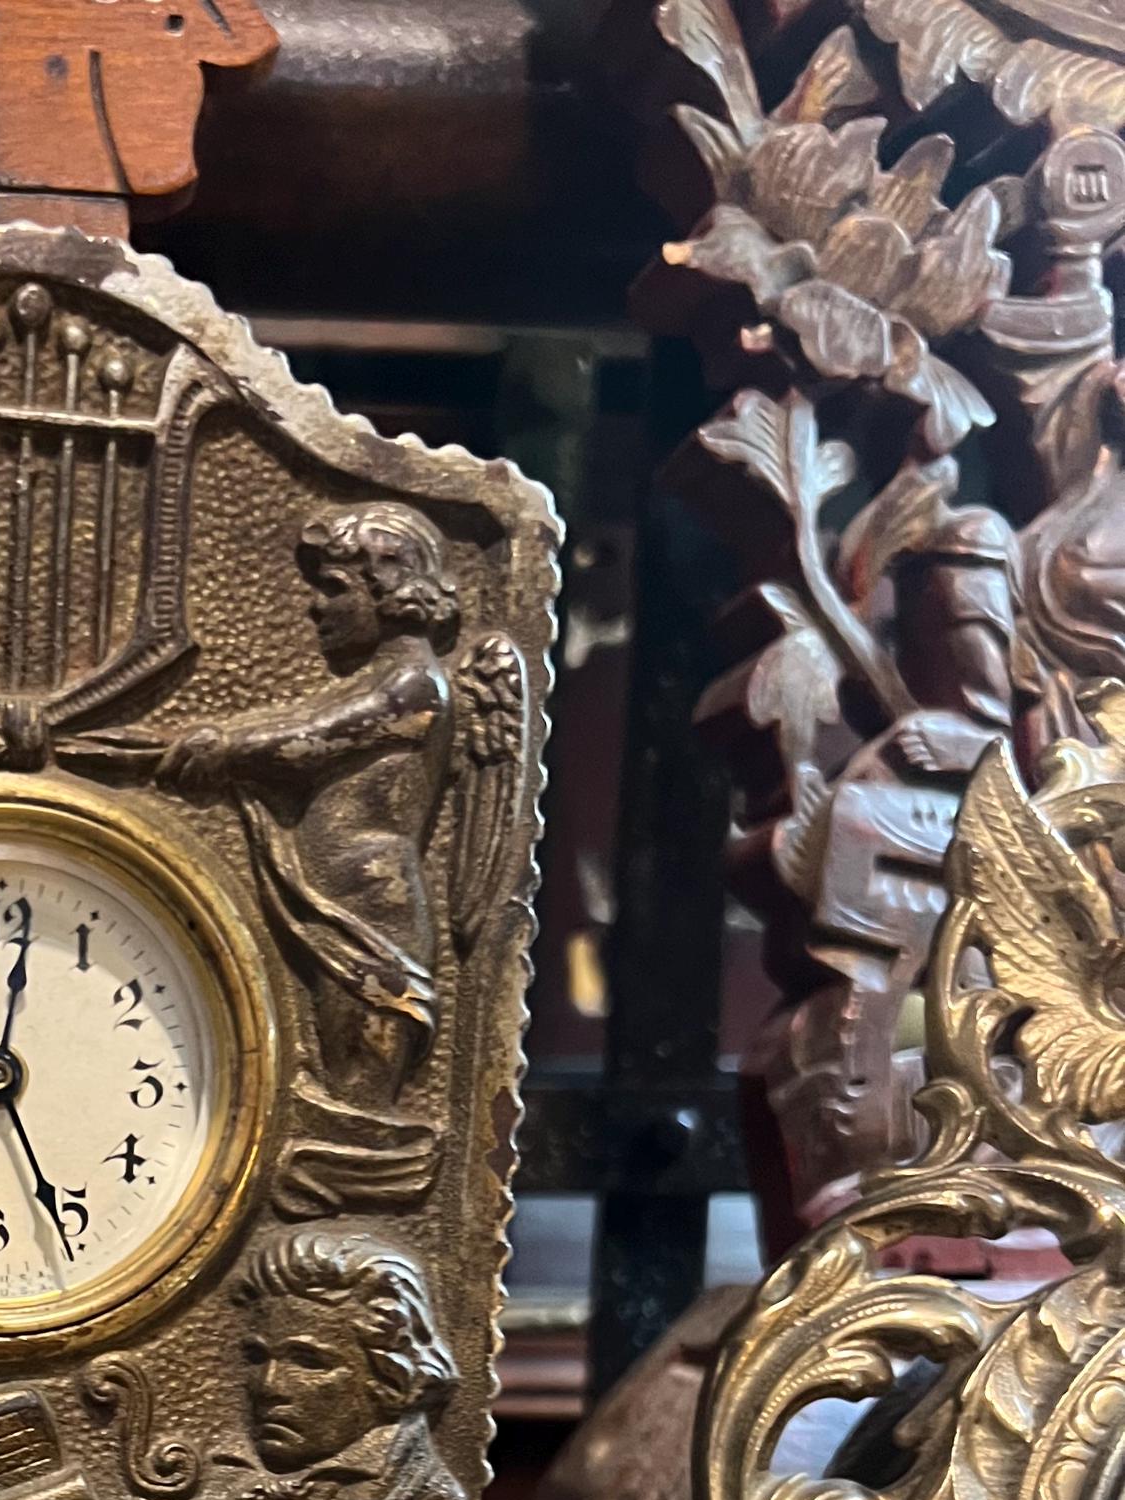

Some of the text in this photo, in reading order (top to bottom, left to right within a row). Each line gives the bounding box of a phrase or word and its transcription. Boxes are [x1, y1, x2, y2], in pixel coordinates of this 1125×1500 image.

[73, 920, 94, 972] 1
[112, 978, 144, 1030] 2
[130, 1058, 164, 1109] 3
[101, 1133, 147, 1183] 4
[57, 1181, 90, 1238] 5
